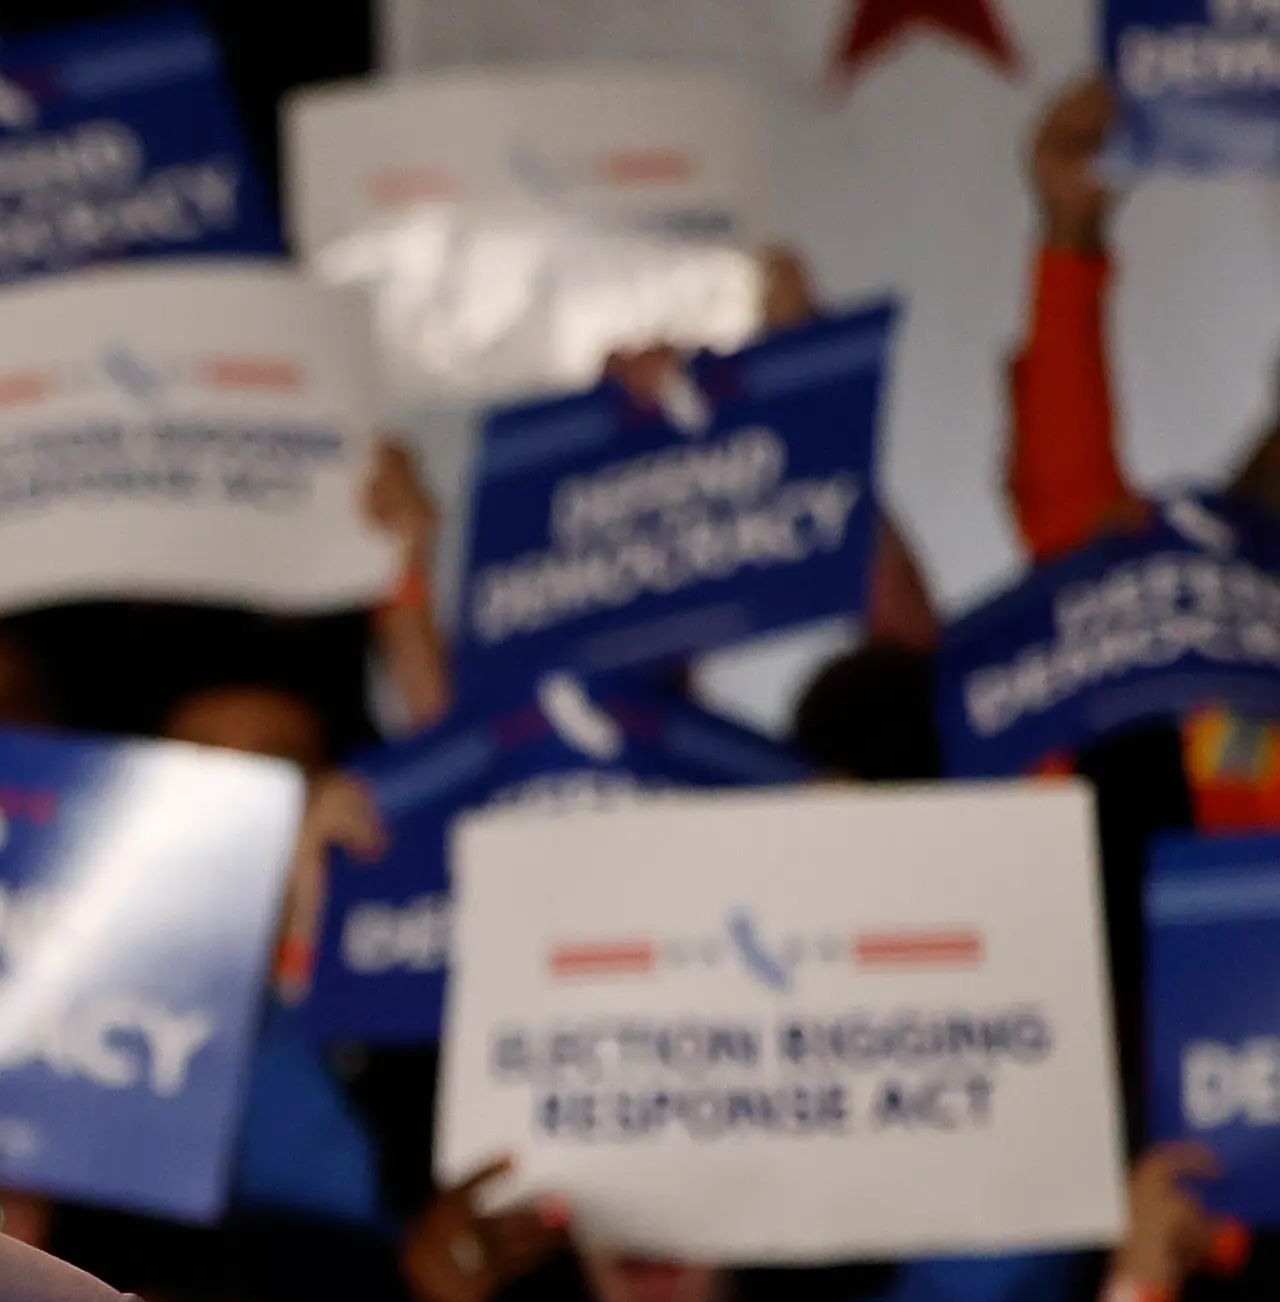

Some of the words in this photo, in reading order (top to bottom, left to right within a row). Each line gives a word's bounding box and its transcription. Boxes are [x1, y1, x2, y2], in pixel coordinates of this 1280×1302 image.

[492, 1014, 762, 1084] ELECTION
[778, 1004, 1054, 1070] RIGGING
[536, 1080, 852, 1144] RESPONSE
[872, 1072, 1000, 1132] ACT
